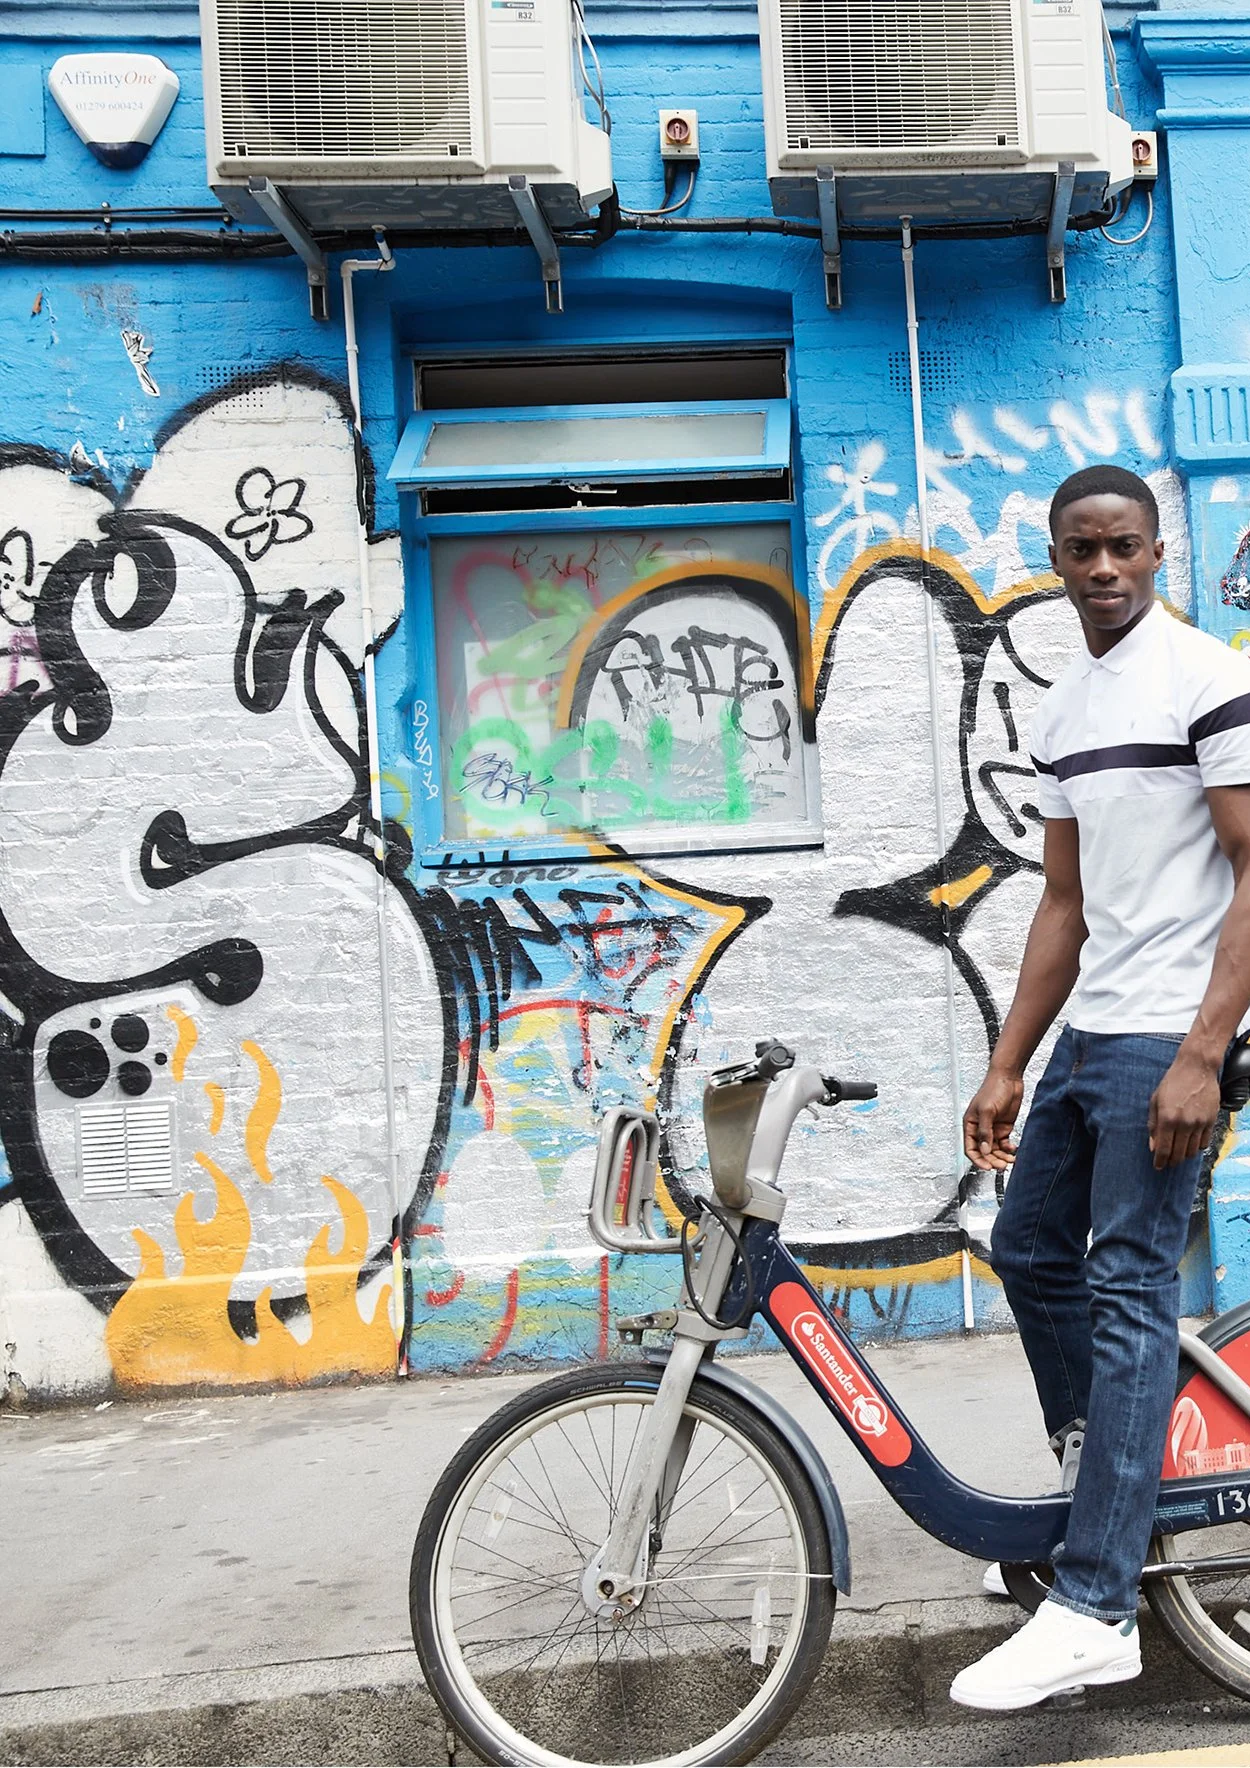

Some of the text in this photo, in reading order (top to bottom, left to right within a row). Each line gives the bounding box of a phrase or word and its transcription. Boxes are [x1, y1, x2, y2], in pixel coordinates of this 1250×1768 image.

[518, 11, 533, 20] R32
[75, 101, 144, 112] 01279 600424
[812, 1332, 858, 1396] Santander
[569, 1380, 623, 1396] SCHWALBE
